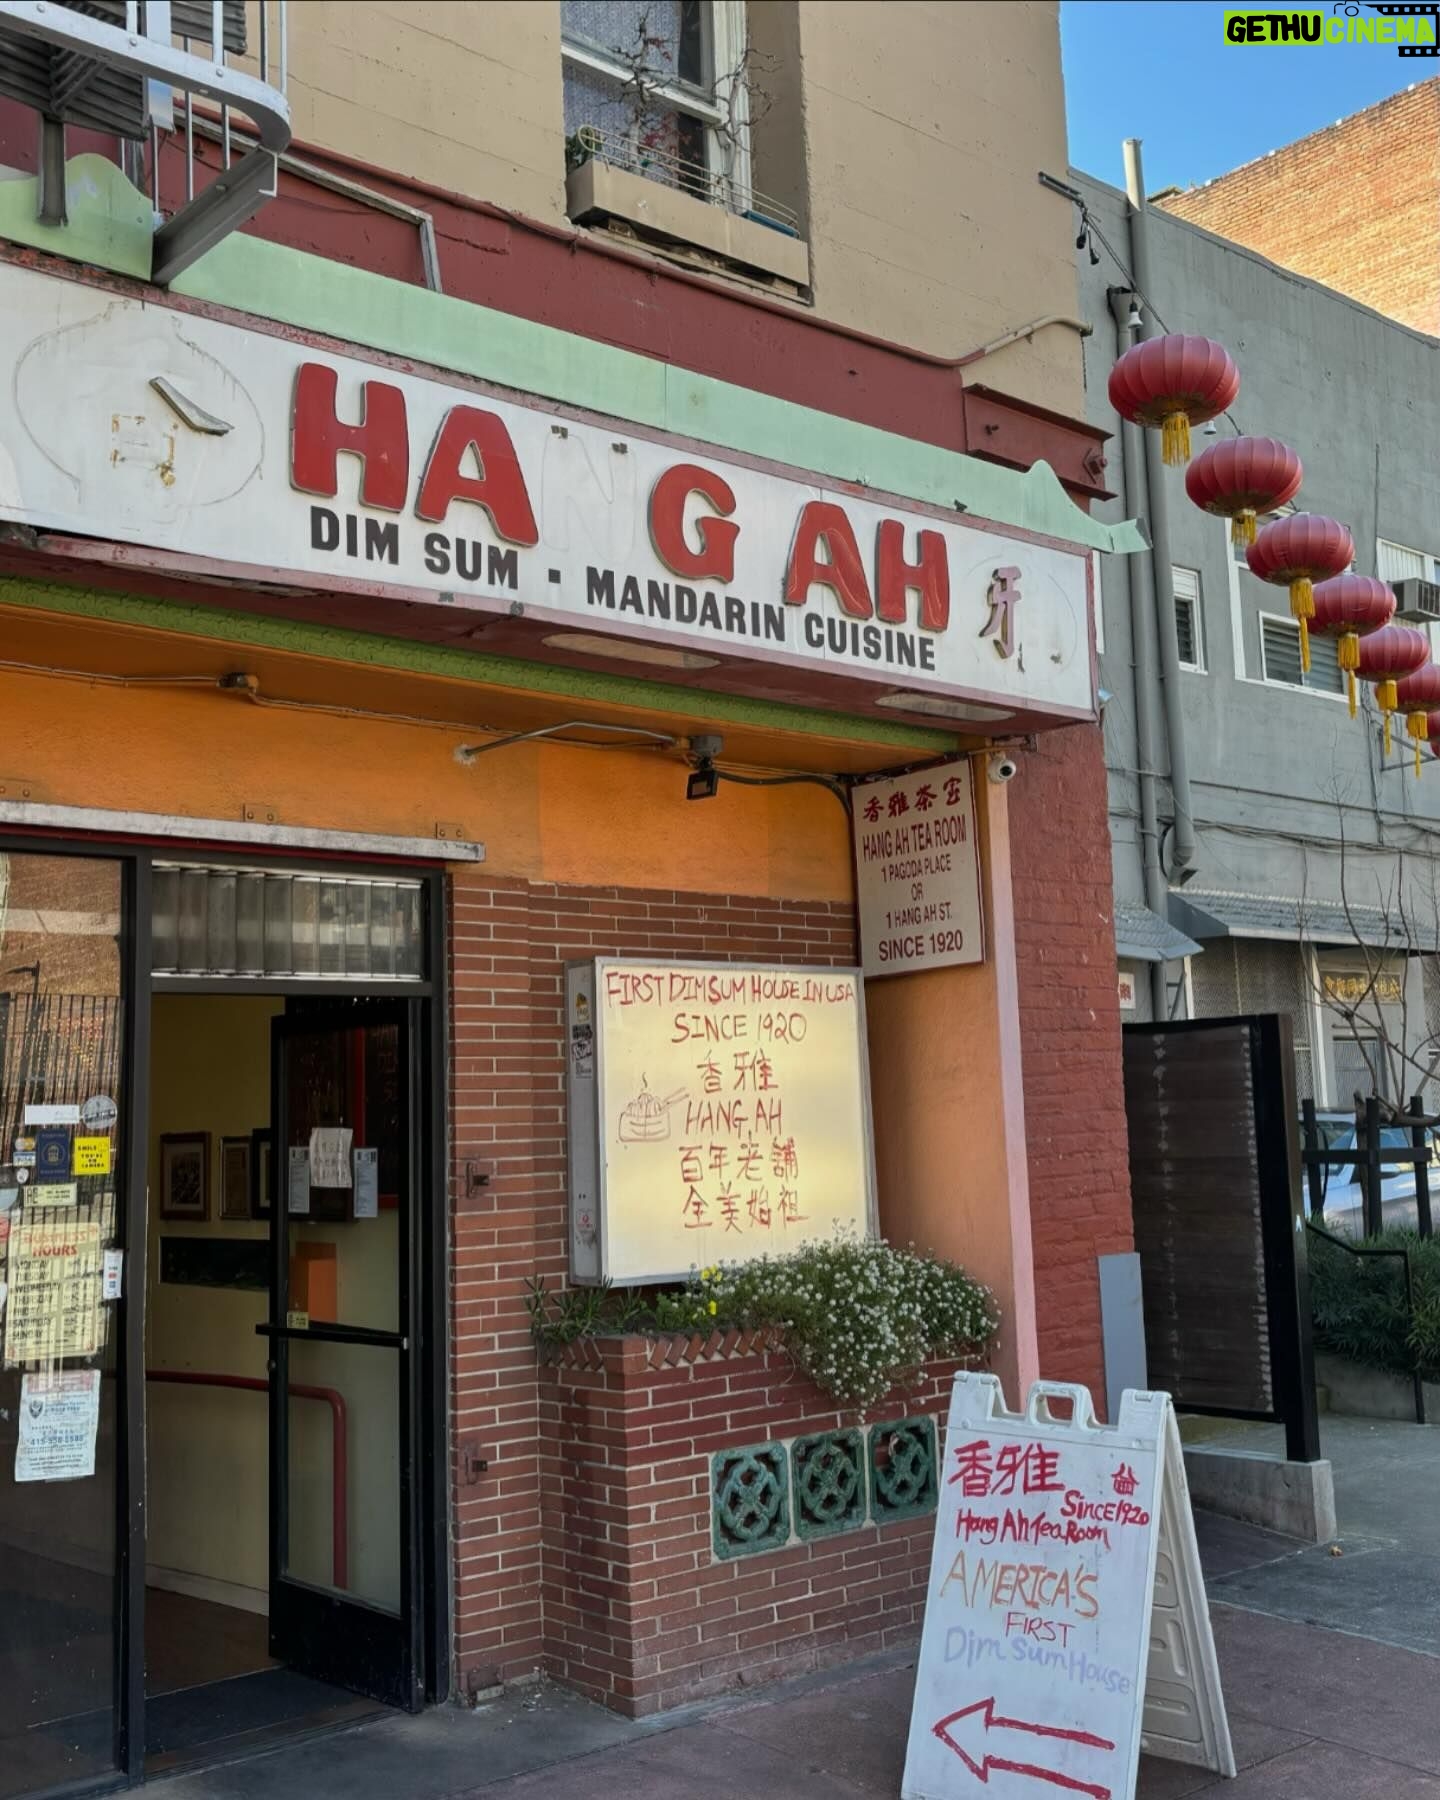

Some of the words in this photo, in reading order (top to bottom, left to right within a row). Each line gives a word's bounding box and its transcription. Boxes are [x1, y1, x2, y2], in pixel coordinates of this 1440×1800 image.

[784, 500, 950, 632] AH
[310, 505, 399, 566] DIM
[424, 532, 518, 590] SUM
[586, 566, 786, 642] MANDARIN
[804, 612, 936, 671] CUISINE
[862, 829, 893, 863] HANG
[895, 827, 910, 856] AH
[911, 822, 933, 852] TEA
[934, 814, 967, 848] ROOM
[881, 866, 887, 883] 1
[889, 859, 923, 881] PAGODA
[924, 853, 952, 876] PLACE
[911, 882, 924, 901] OR
[886, 911, 892, 929] 1
[894, 906, 921, 928] HANG
[923, 904, 937, 923] AH
[878, 935, 925, 962] SINCE
[929, 929, 963, 955] 1920
[606, 972, 665, 1007] FIRST
[751, 974, 800, 1004] HOUSE
[802, 982, 824, 1003] IN
[825, 982, 856, 1003] USA
[671, 1012, 748, 1044] SINCE
[757, 1012, 808, 1045] 1920
[685, 1100, 749, 1140] HANG
[755, 1097, 782, 1136] AH
[32, 1244, 78, 1257] HOURS
[947, 1439, 1066, 1498] 香雅
[1114, 1499, 1151, 1527] 1920
[939, 1549, 1100, 1619] AMERICA'S
[1005, 1611, 1077, 1649] FIRST
